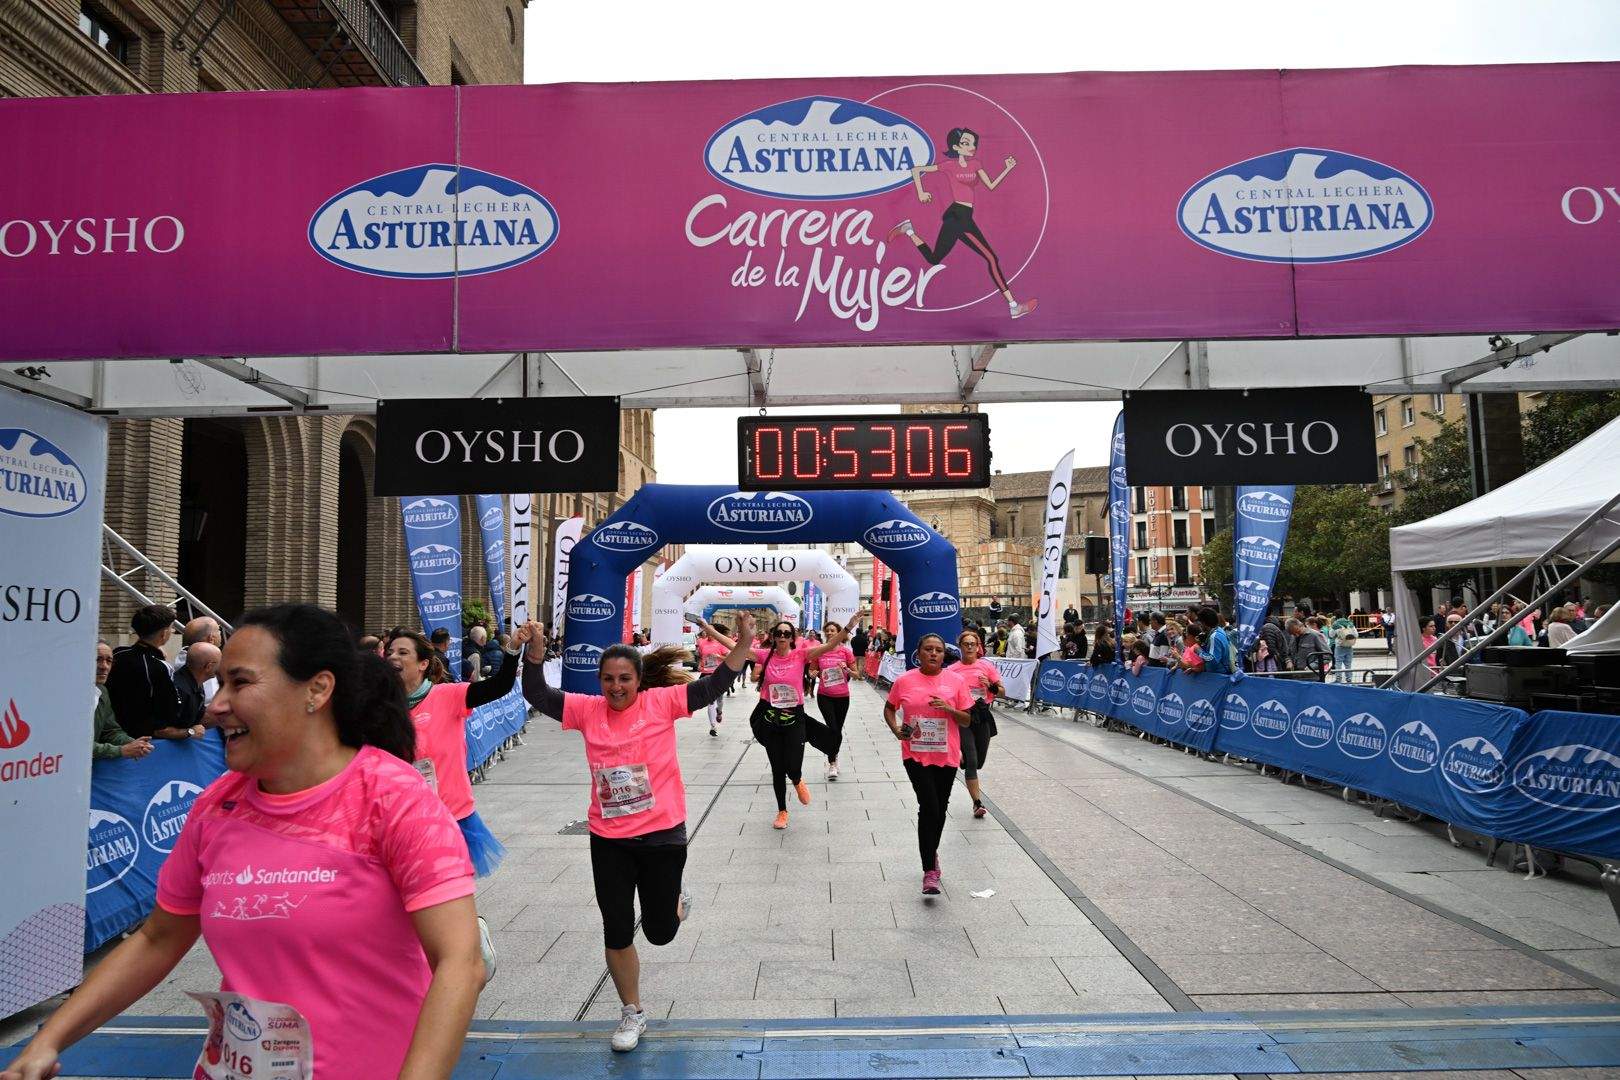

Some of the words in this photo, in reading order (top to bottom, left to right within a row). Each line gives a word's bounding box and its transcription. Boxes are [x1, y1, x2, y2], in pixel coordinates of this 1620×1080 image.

[757, 132, 829, 143] CENTRAL
[836, 130, 909, 142] LECHERA
[722, 135, 915, 174] ASTURIANA
[1236, 188, 1315, 200] CENTRAL
[1323, 185, 1405, 198] LECHERA
[367, 202, 444, 216] CENTRAL
[451, 201, 533, 215] LECHERA
[1199, 191, 1415, 235] ASTURIANA
[328, 208, 540, 251] ASTURIANA
[685, 194, 875, 248] Carrera
[0, 215, 185, 257] OYSHO
[731, 250, 766, 287] de
[774, 249, 800, 287] la
[794, 241, 947, 332] Mujer
[415, 429, 585, 464] OYSHO
[1165, 420, 1339, 458] OYSHO
[33, 462, 76, 479] LECHERA
[715, 503, 806, 523] ASTURIANA
[596, 531, 653, 544] ASTURIANA
[869, 531, 927, 543] ASTURIANA
[1240, 547, 1279, 562] STURIAN
[715, 556, 797, 574] OYSHO
[569, 604, 612, 616] ASTURIANA
[912, 602, 957, 614] ASTURIANA
[565, 653, 601, 665] ASTURIA
[993, 660, 1023, 679] SHO
[1253, 712, 1287, 732] ASTURIANA
[1295, 718, 1331, 741] ASTURIANA
[1339, 726, 1382, 751] ASTURIANA
[1391, 737, 1435, 765] ASTURIAN
[0, 751, 64, 782] ander
[87, 835, 135, 871] URIANA
[254, 866, 338, 885] Santander
[267, 1021, 300, 1030] SUMA
